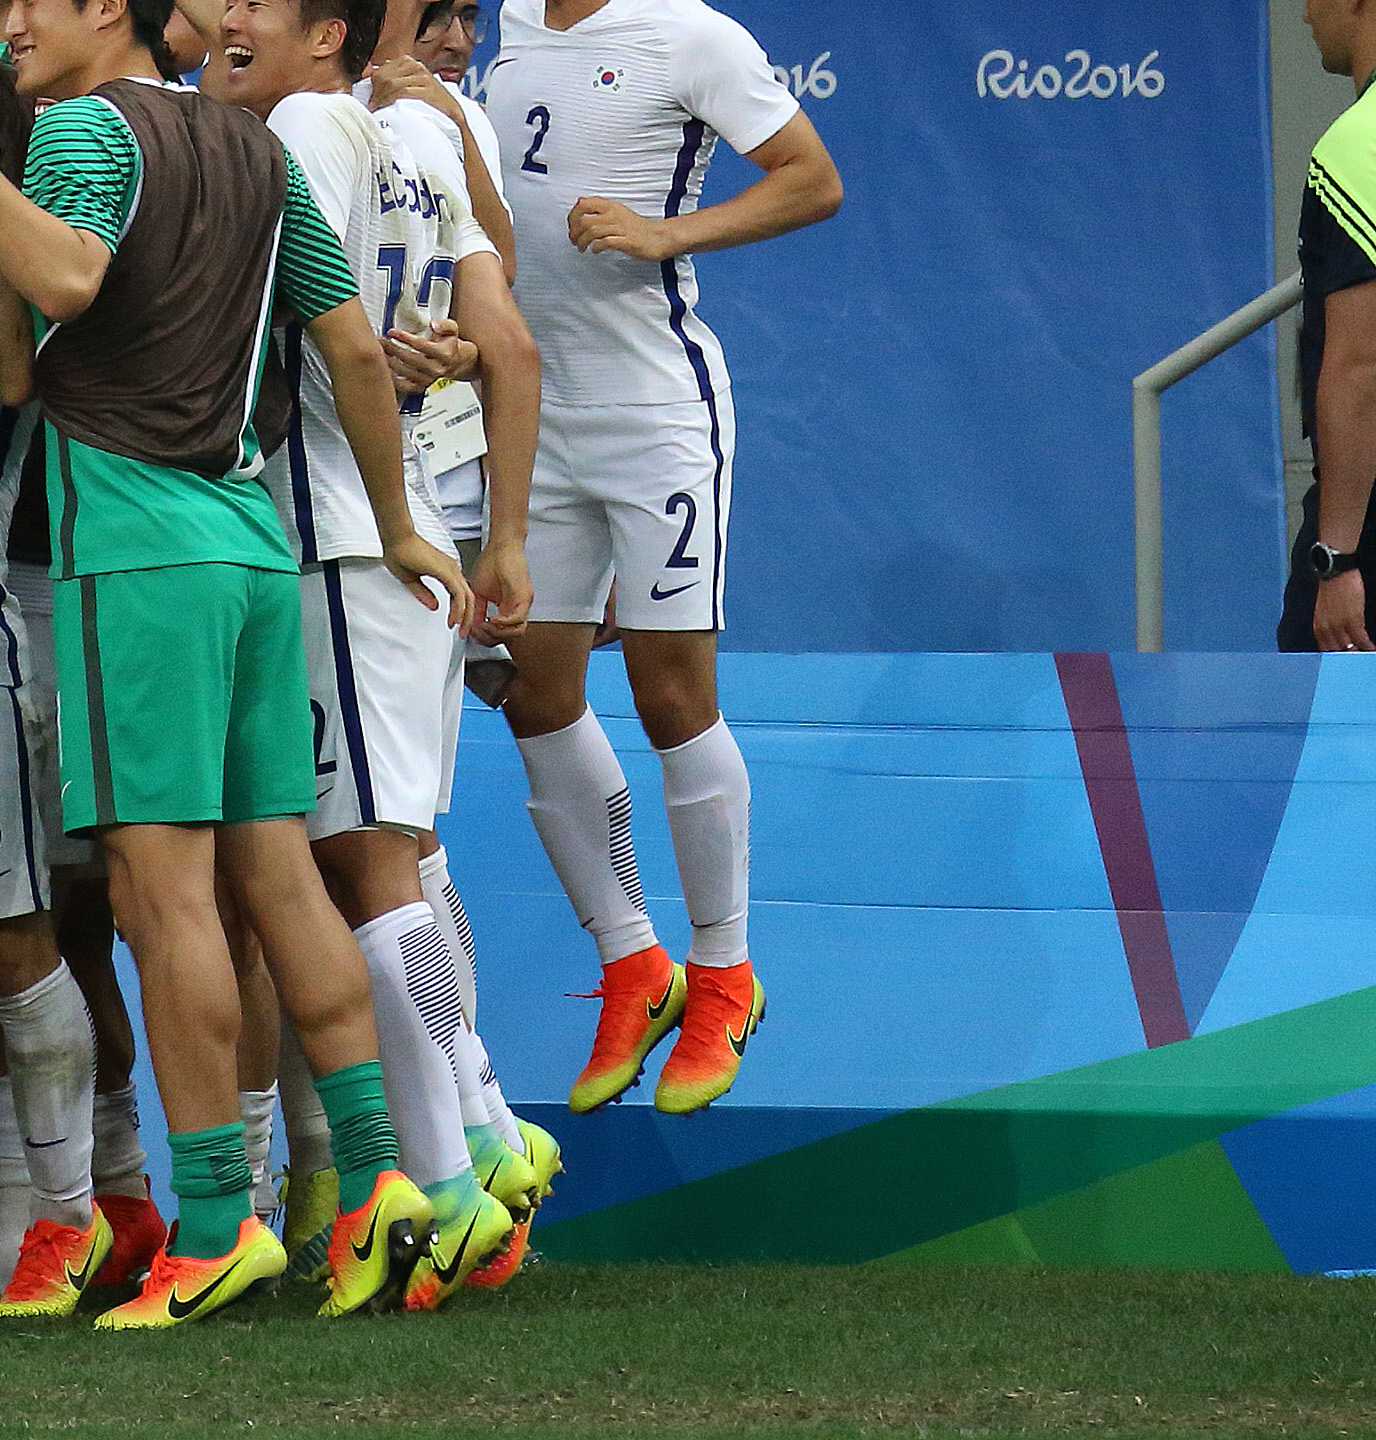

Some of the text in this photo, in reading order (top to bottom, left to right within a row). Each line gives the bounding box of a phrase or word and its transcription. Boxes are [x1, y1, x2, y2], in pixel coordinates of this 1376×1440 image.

[976, 48, 1166, 100] Rio2016
[520, 105, 551, 176] 2
[664, 491, 700, 570] 2
